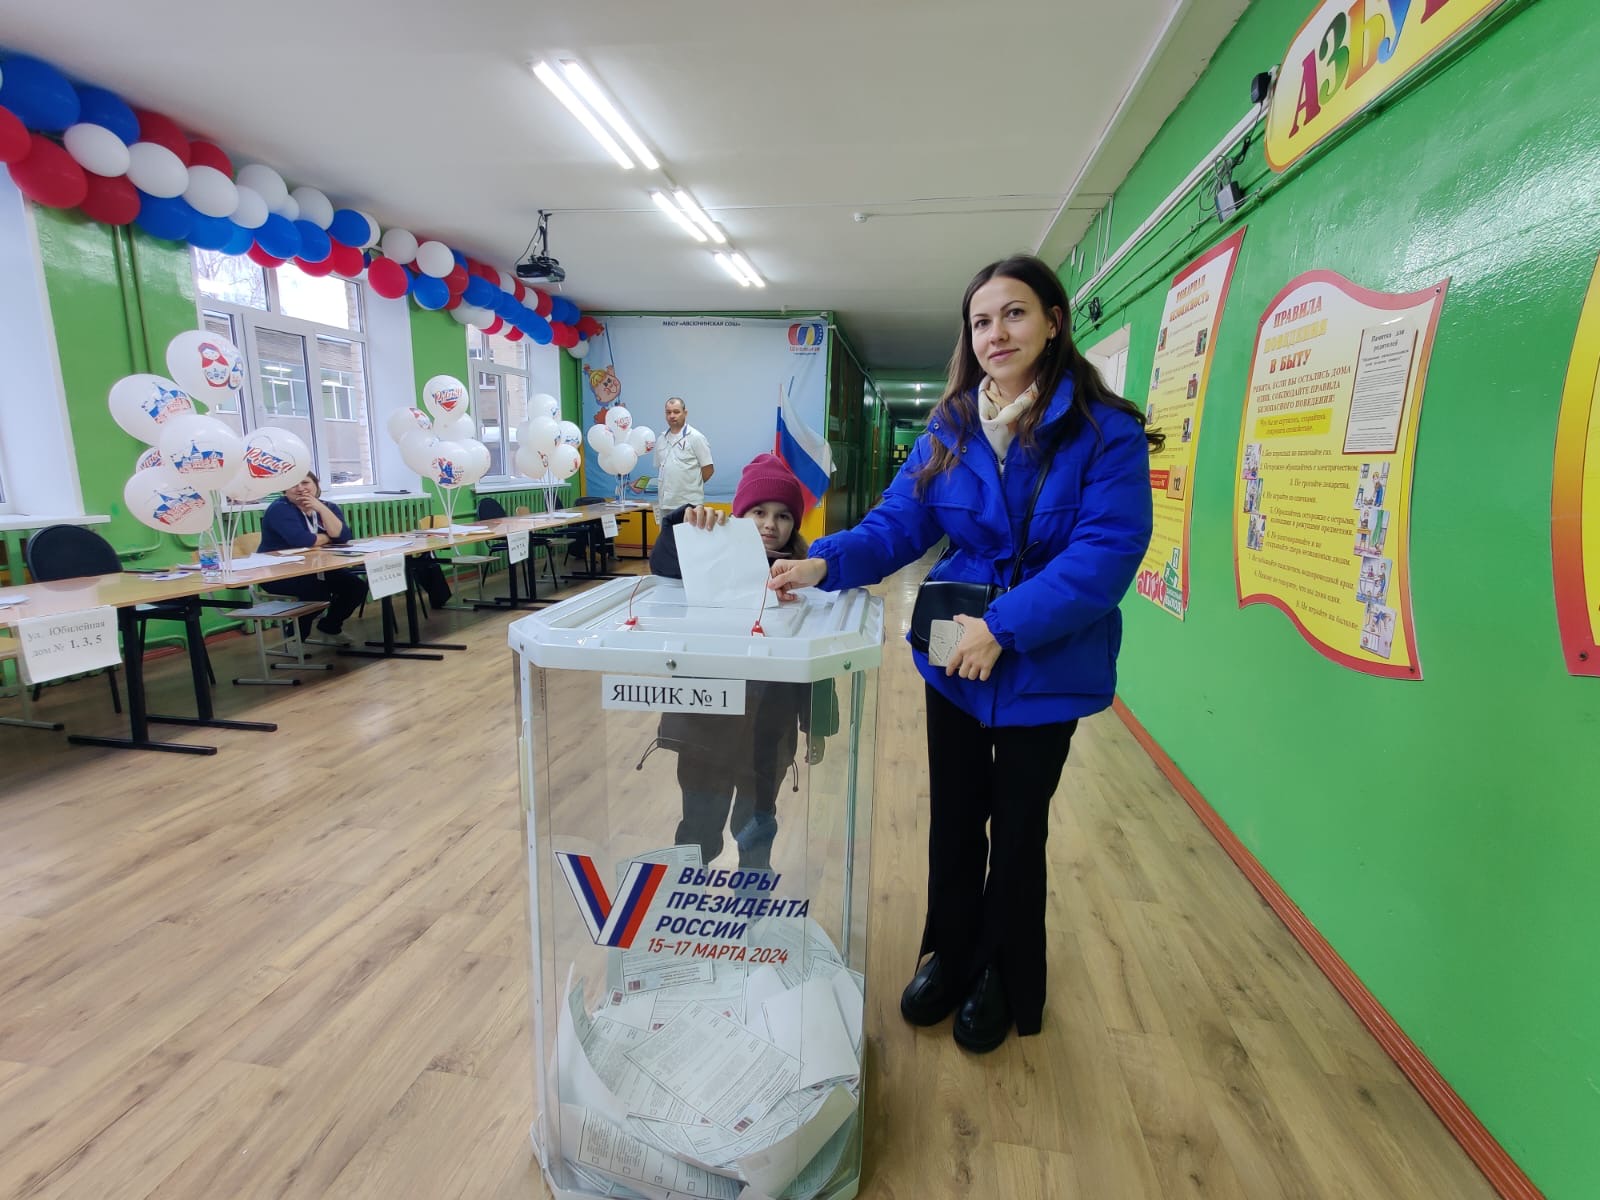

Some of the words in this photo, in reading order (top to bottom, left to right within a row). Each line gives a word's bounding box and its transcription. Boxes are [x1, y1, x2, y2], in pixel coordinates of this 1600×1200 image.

[1288, 0, 1450, 138] АЗБУ
[1273, 296, 1322, 328] ПРАВИЛА
[1269, 358, 1276, 374] В
[1280, 348, 1312, 371] БЫТУ
[49, 621, 105, 636] Юбилейная
[611, 684, 683, 706] ЯЩИК
[690, 688, 712, 707] №
[720, 690, 728, 707] 1
[678, 867, 782, 892] ВЫБОРЫ
[666, 892, 810, 918] ПРЕЗИДЕНТА
[655, 915, 748, 940] РОССИИ
[692, 943, 746, 962] МАРТА
[748, 947, 788, 964] 2024
